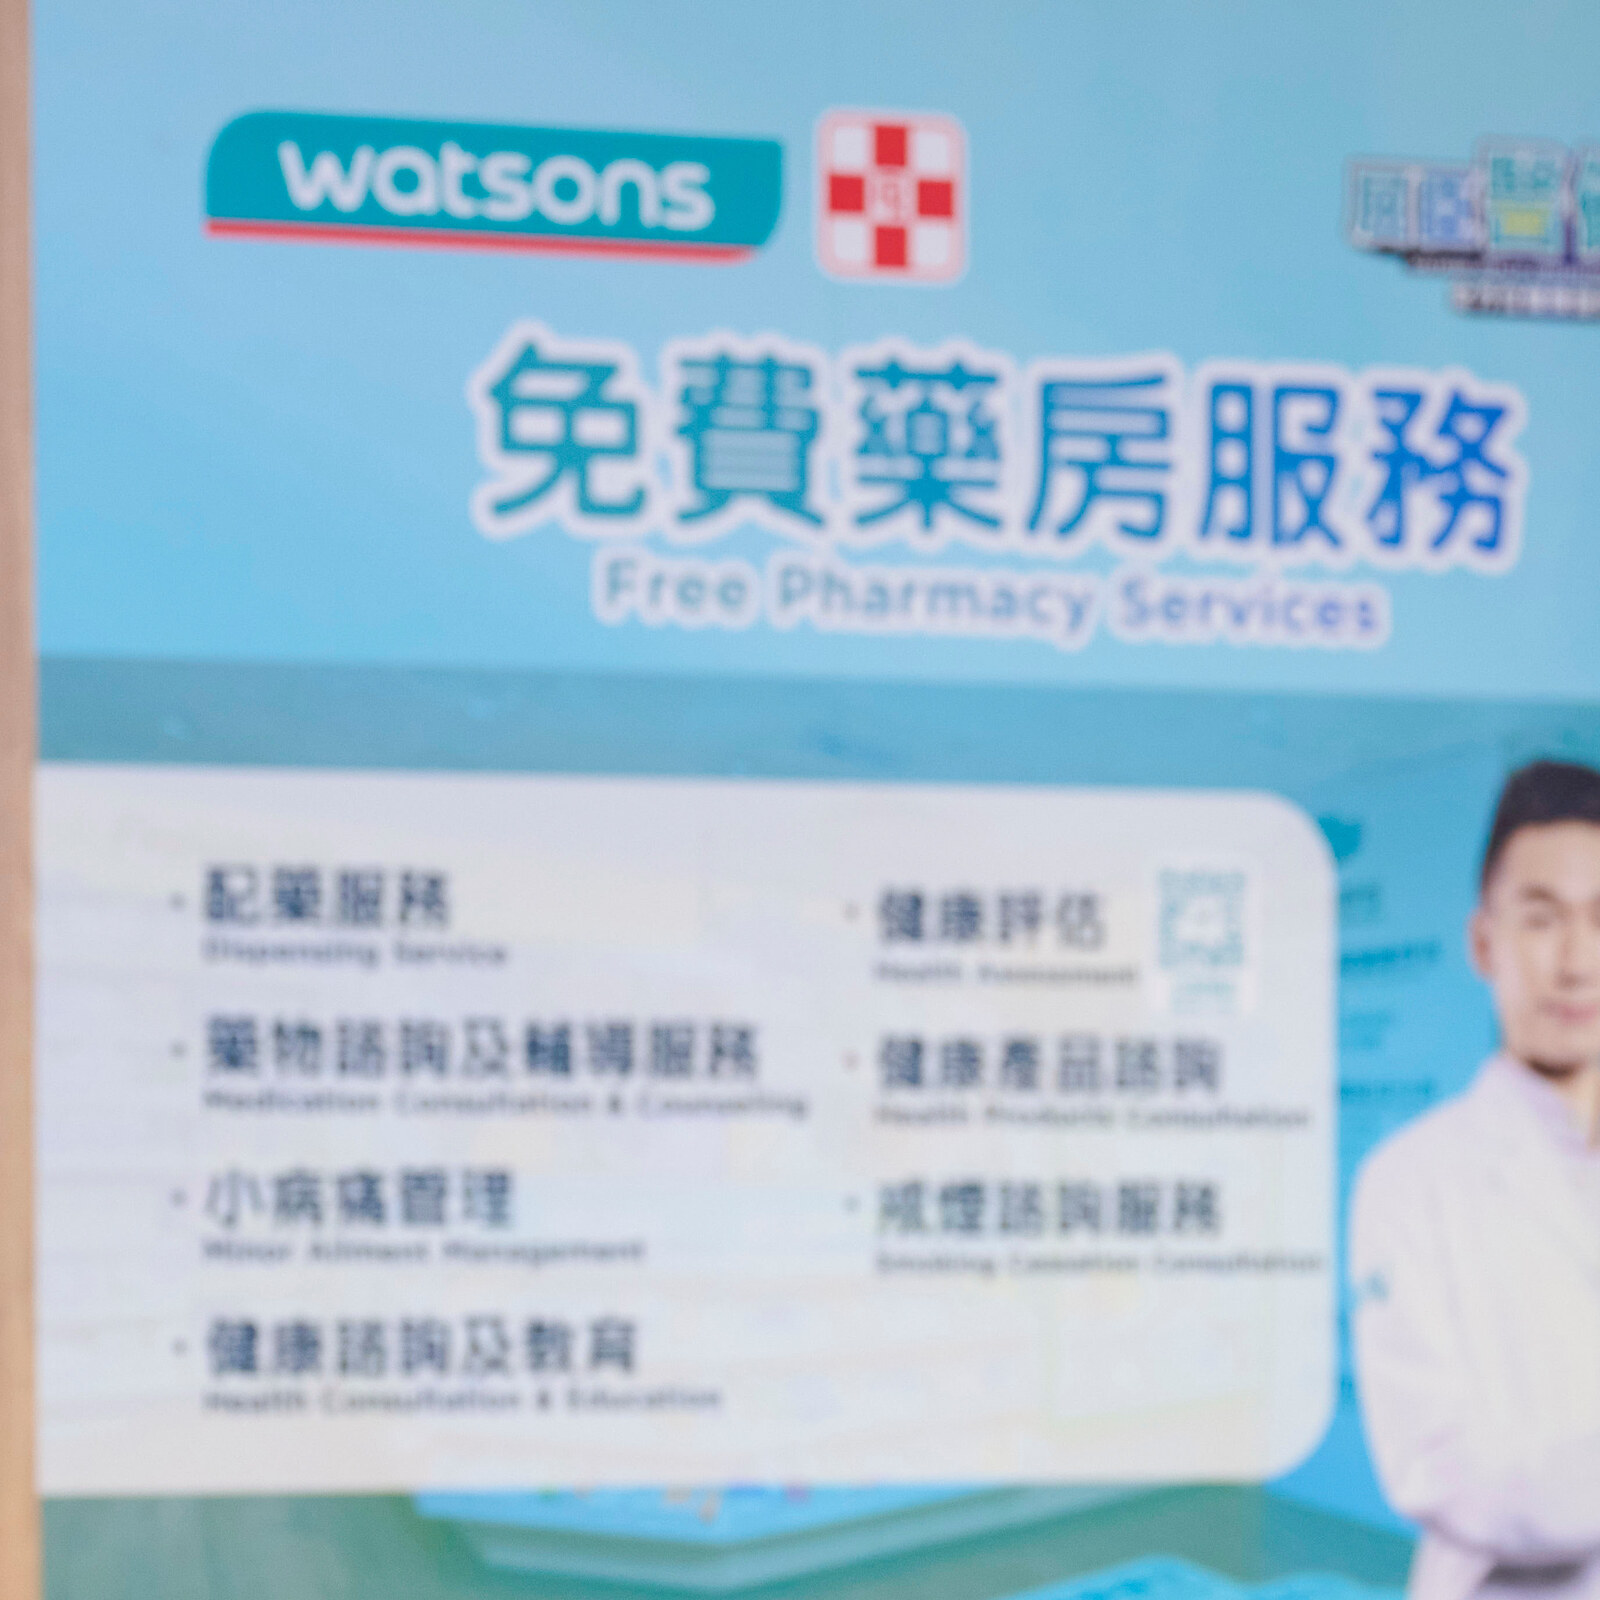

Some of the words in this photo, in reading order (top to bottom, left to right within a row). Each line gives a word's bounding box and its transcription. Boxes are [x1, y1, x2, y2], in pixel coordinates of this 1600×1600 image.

[279, 138, 715, 233] watsons
[478, 338, 1516, 558] 免費藥房服務
[602, 558, 752, 622] Free
[780, 565, 1096, 650] Pharmacy
[1116, 577, 1384, 643] Services
[203, 864, 451, 929] 配藥服務
[877, 888, 1106, 950] 健康評估
[879, 1036, 1220, 1092] 健康產品諮詢
[203, 1165, 513, 1228] 小病痛管理
[206, 1315, 639, 1377] 健康諮詢及教育
